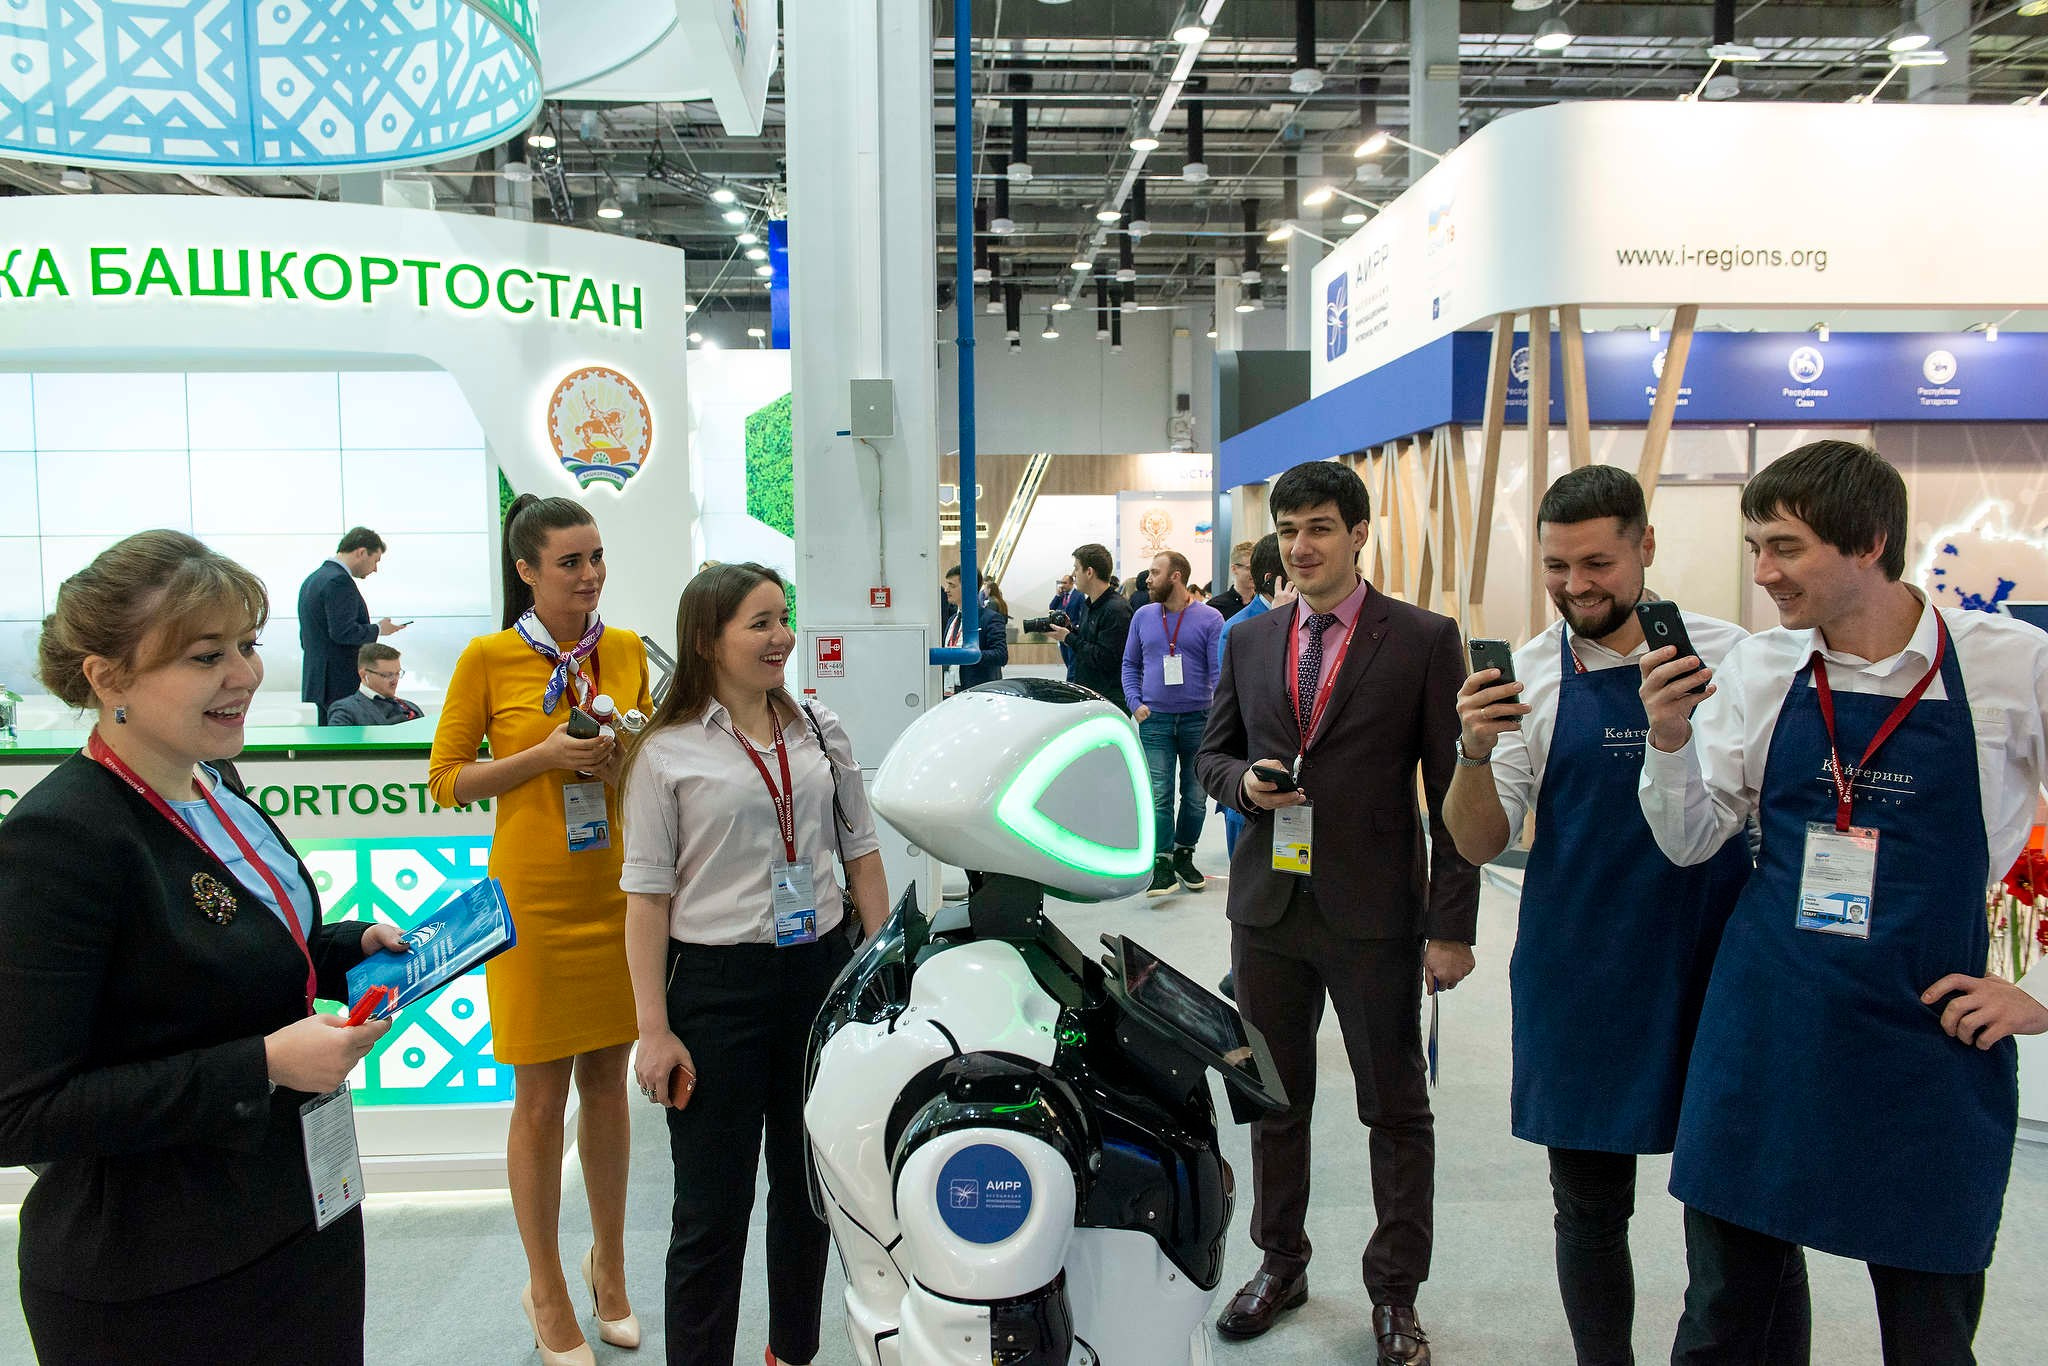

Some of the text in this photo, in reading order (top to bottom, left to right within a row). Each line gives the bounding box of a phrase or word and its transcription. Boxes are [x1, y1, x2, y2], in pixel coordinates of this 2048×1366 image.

[1616, 243, 1828, 272] www.i-regions.org
[90, 247, 643, 330] БАШКОРТОСТАН
[1604, 727, 1648, 739] Кейте
[1821, 758, 1914, 785] Кйтеринг
[986, 1180, 1022, 1191] АИРР
